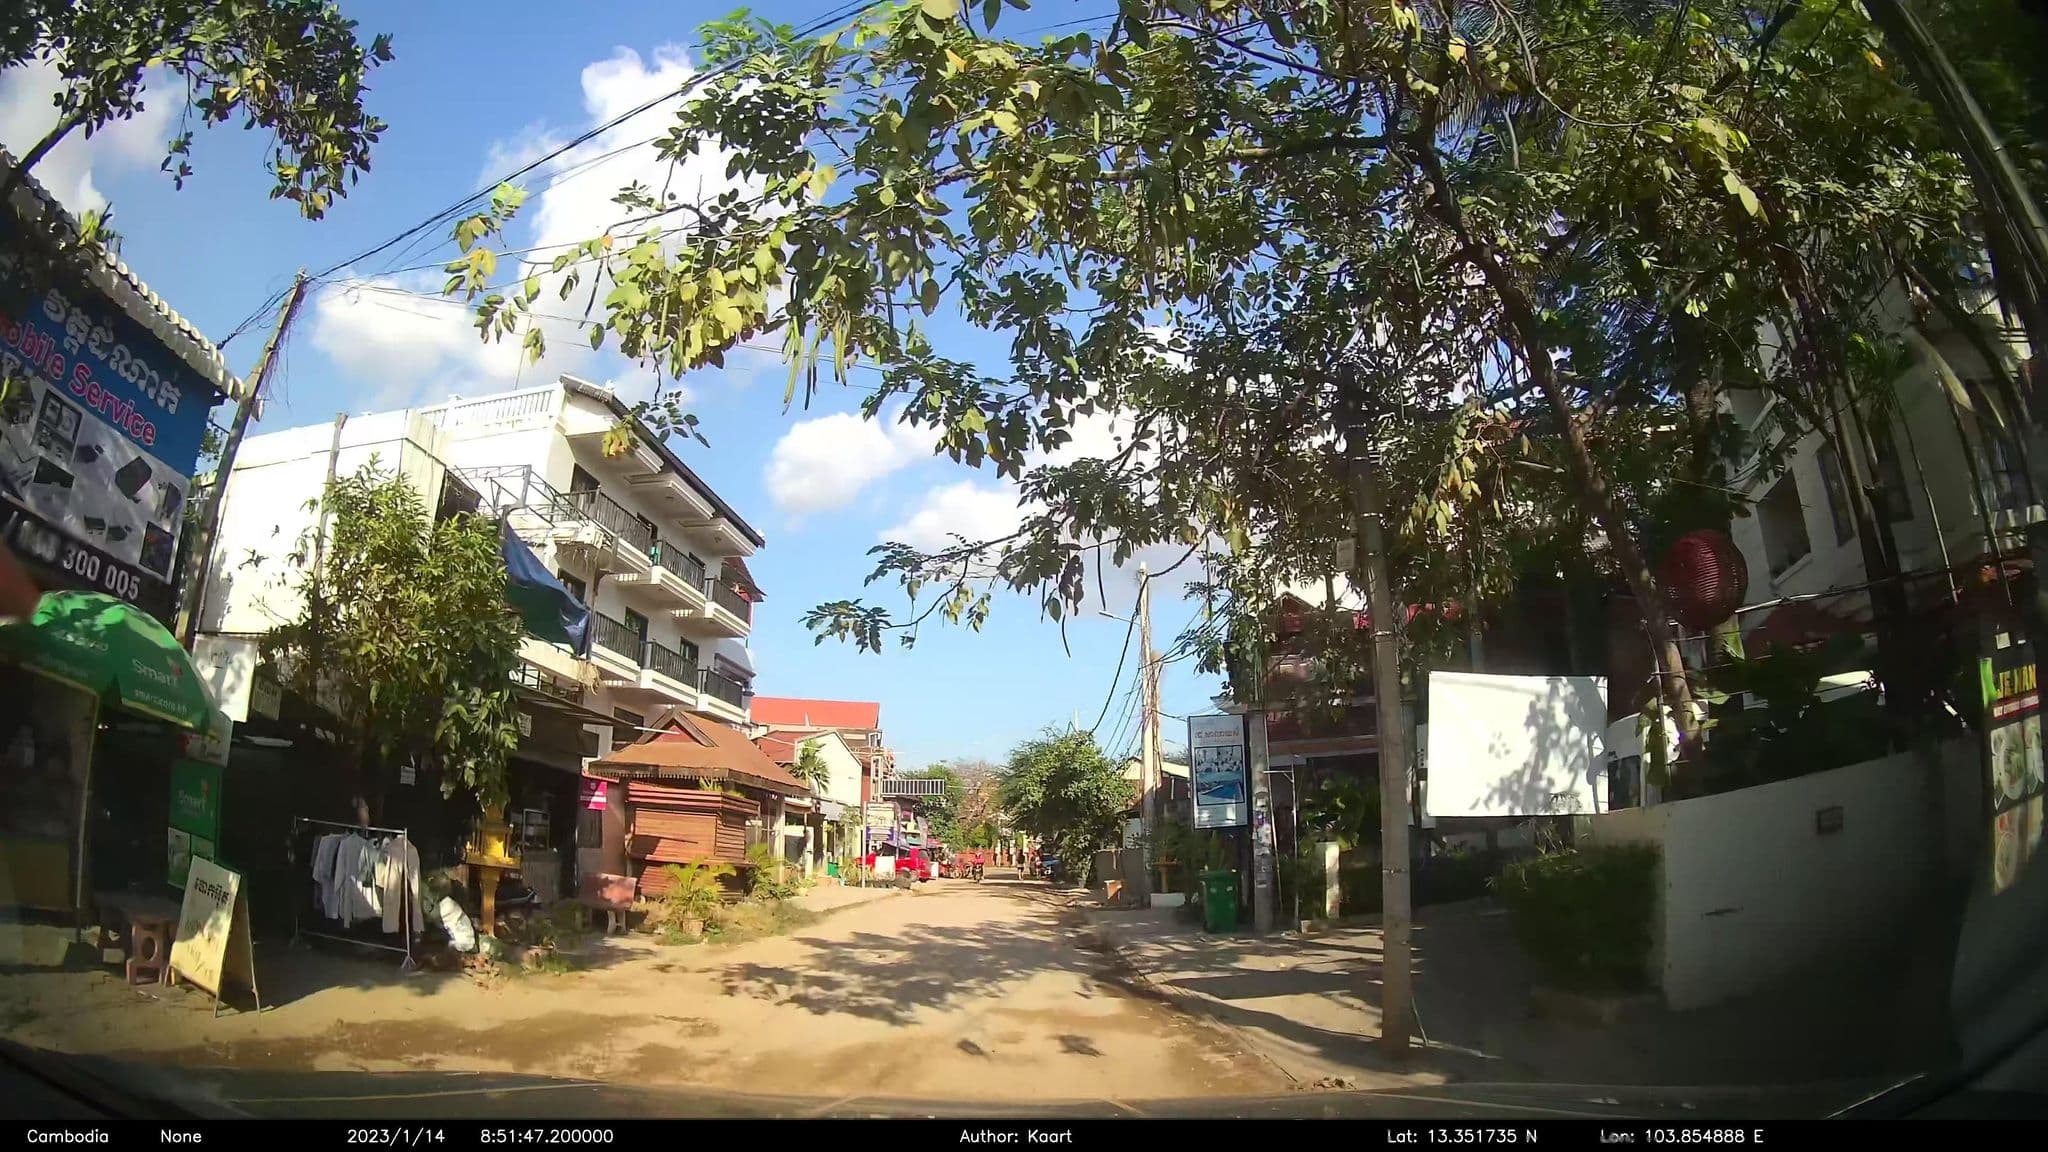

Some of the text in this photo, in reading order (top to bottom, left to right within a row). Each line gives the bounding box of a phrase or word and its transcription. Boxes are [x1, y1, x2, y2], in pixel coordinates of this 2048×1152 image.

[68, 362, 156, 446] Service
[63, 543, 141, 601] 300 005
[131, 657, 180, 688] Smart
